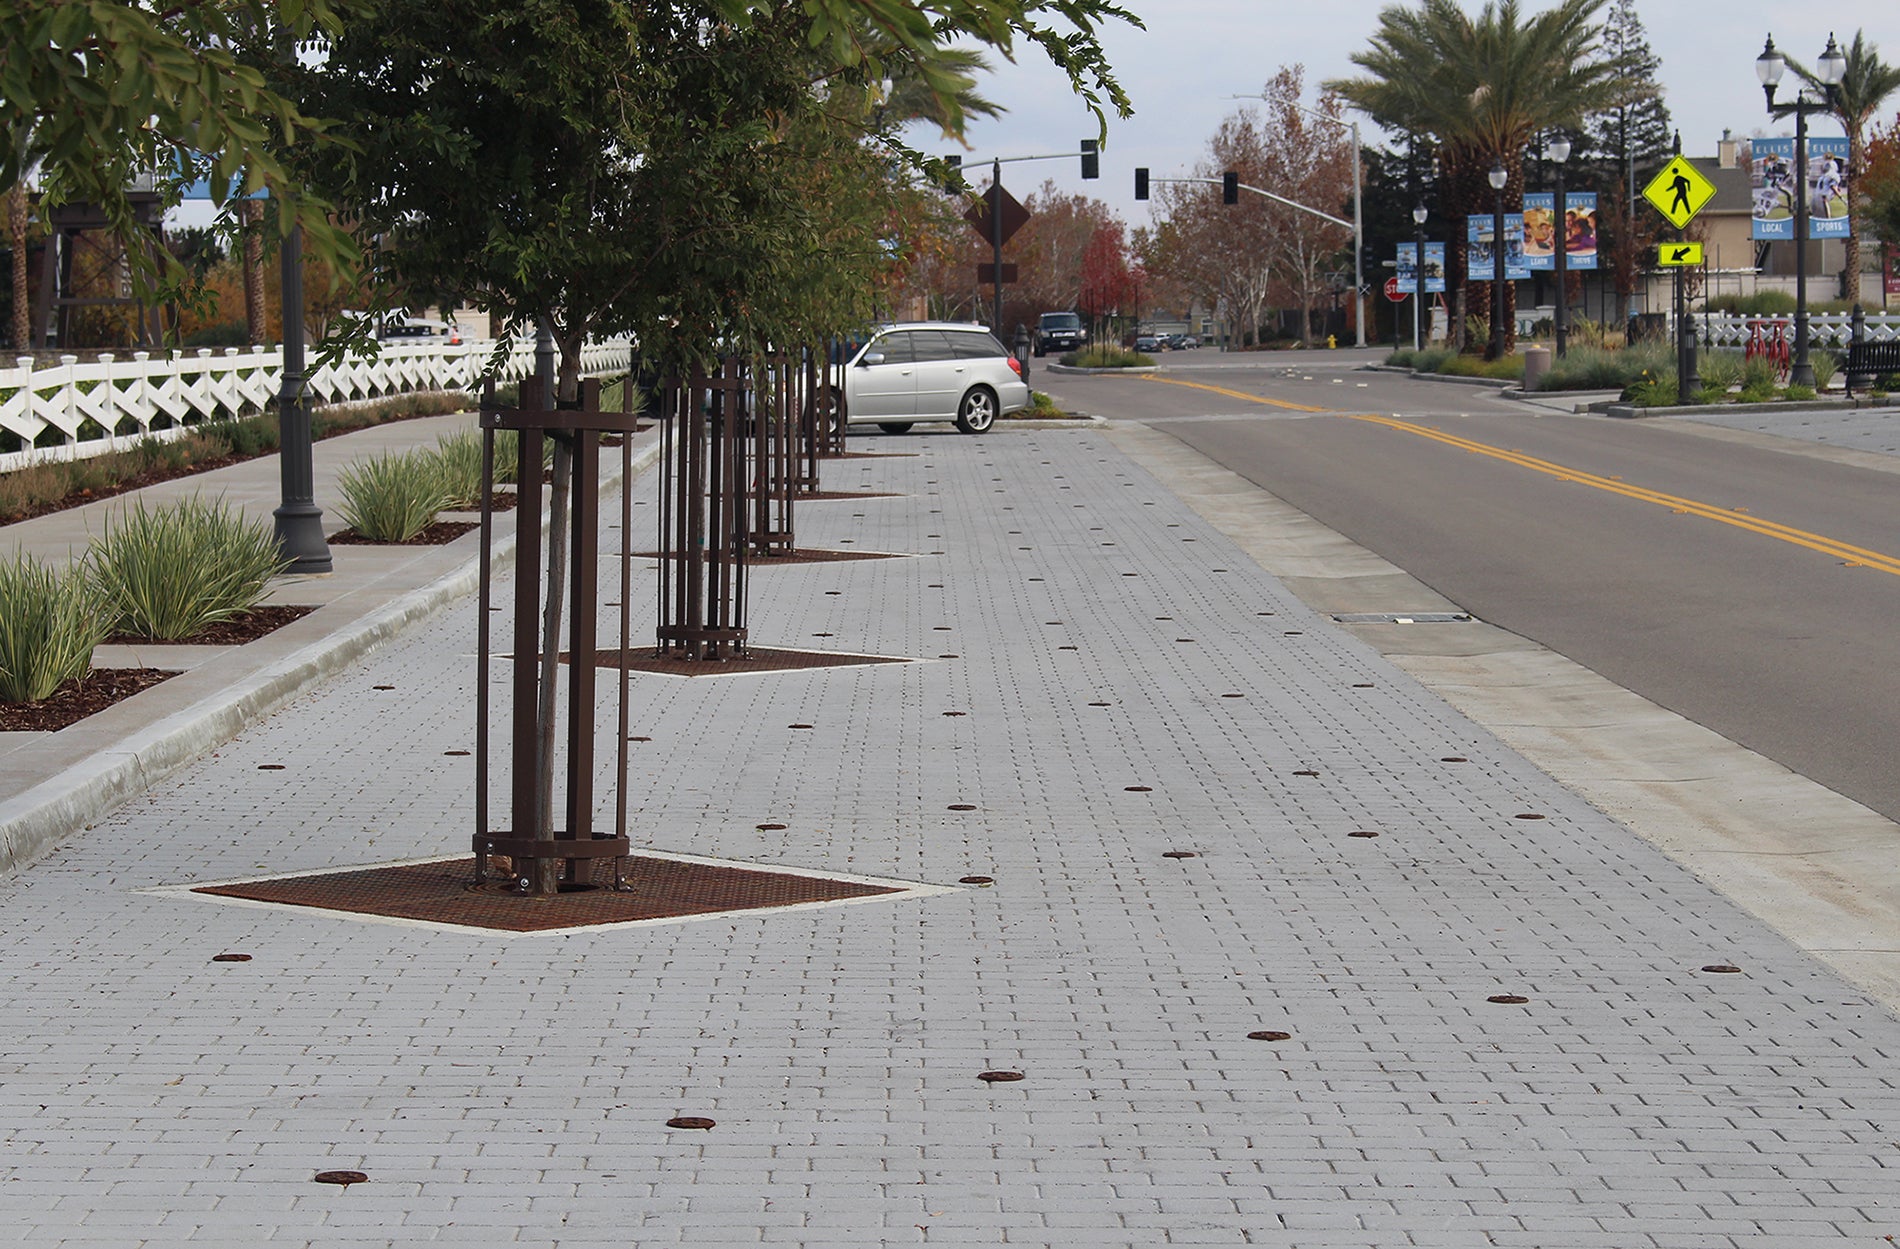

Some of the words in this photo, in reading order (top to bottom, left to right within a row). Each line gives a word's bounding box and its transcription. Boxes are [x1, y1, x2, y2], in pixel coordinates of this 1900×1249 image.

[1756, 144, 1789, 154] ELLIS
[1812, 144, 1846, 153] ELLIS
[1761, 223, 1783, 233] LOCAL
[1816, 222, 1843, 232] SPORTS
